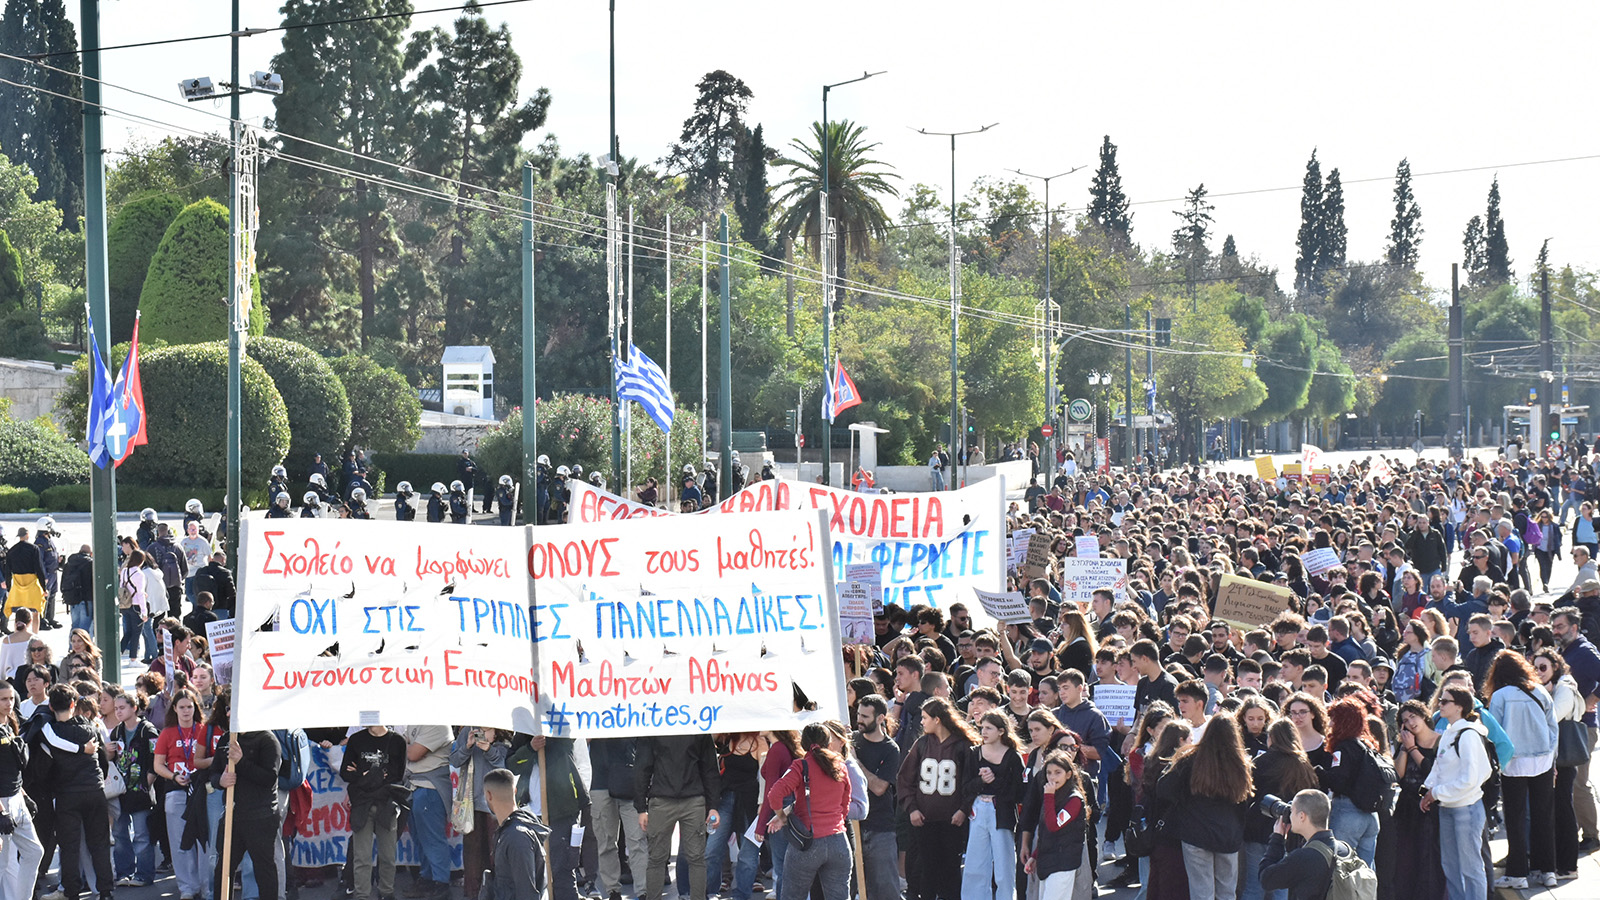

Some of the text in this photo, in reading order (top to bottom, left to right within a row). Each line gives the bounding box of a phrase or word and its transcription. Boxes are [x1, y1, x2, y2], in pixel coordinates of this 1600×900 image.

[262, 521, 815, 584] Σχολείο να μορφώνει ΟΛΟΥΣ τους μαθητές!
[871, 530, 989, 584] ΦΕΡΝΕΤΕ
[290, 594, 825, 643] ΟΧΙ ΣΤΙΣ ΤΡΙΠΛΕΣ ΠΑΝΕΛΛΑΔΙΚΕΣ!
[262, 649, 778, 704] Συντονιστική Επιτροπή Μαθητών Αθήνας
[541, 701, 723, 736] #mathites.gr
[919, 757, 957, 796] 98
